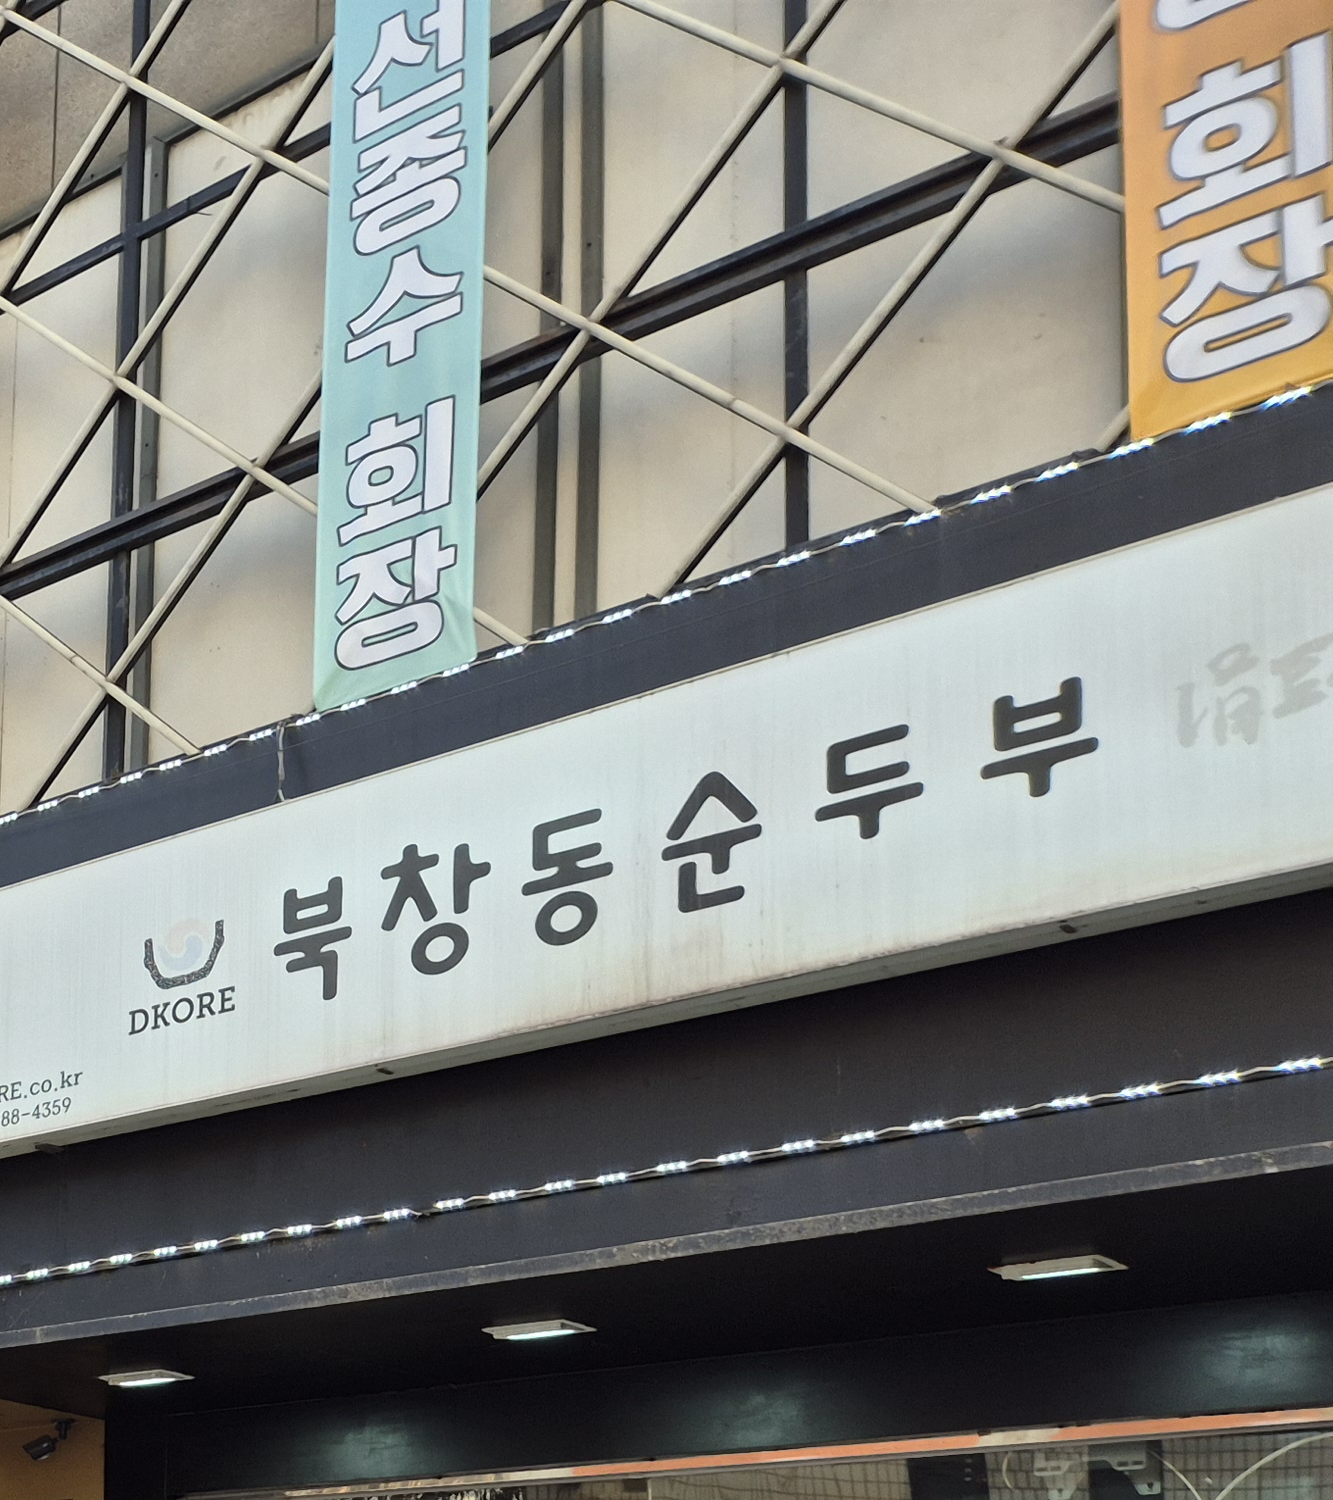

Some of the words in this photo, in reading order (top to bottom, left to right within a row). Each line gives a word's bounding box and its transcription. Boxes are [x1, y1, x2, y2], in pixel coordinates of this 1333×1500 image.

[1157, 28, 1333, 384] 회장
[334, 396, 459, 671] 회장
[272, 675, 1100, 1001] 북창동순두부
[127, 985, 236, 1038] DKORE
